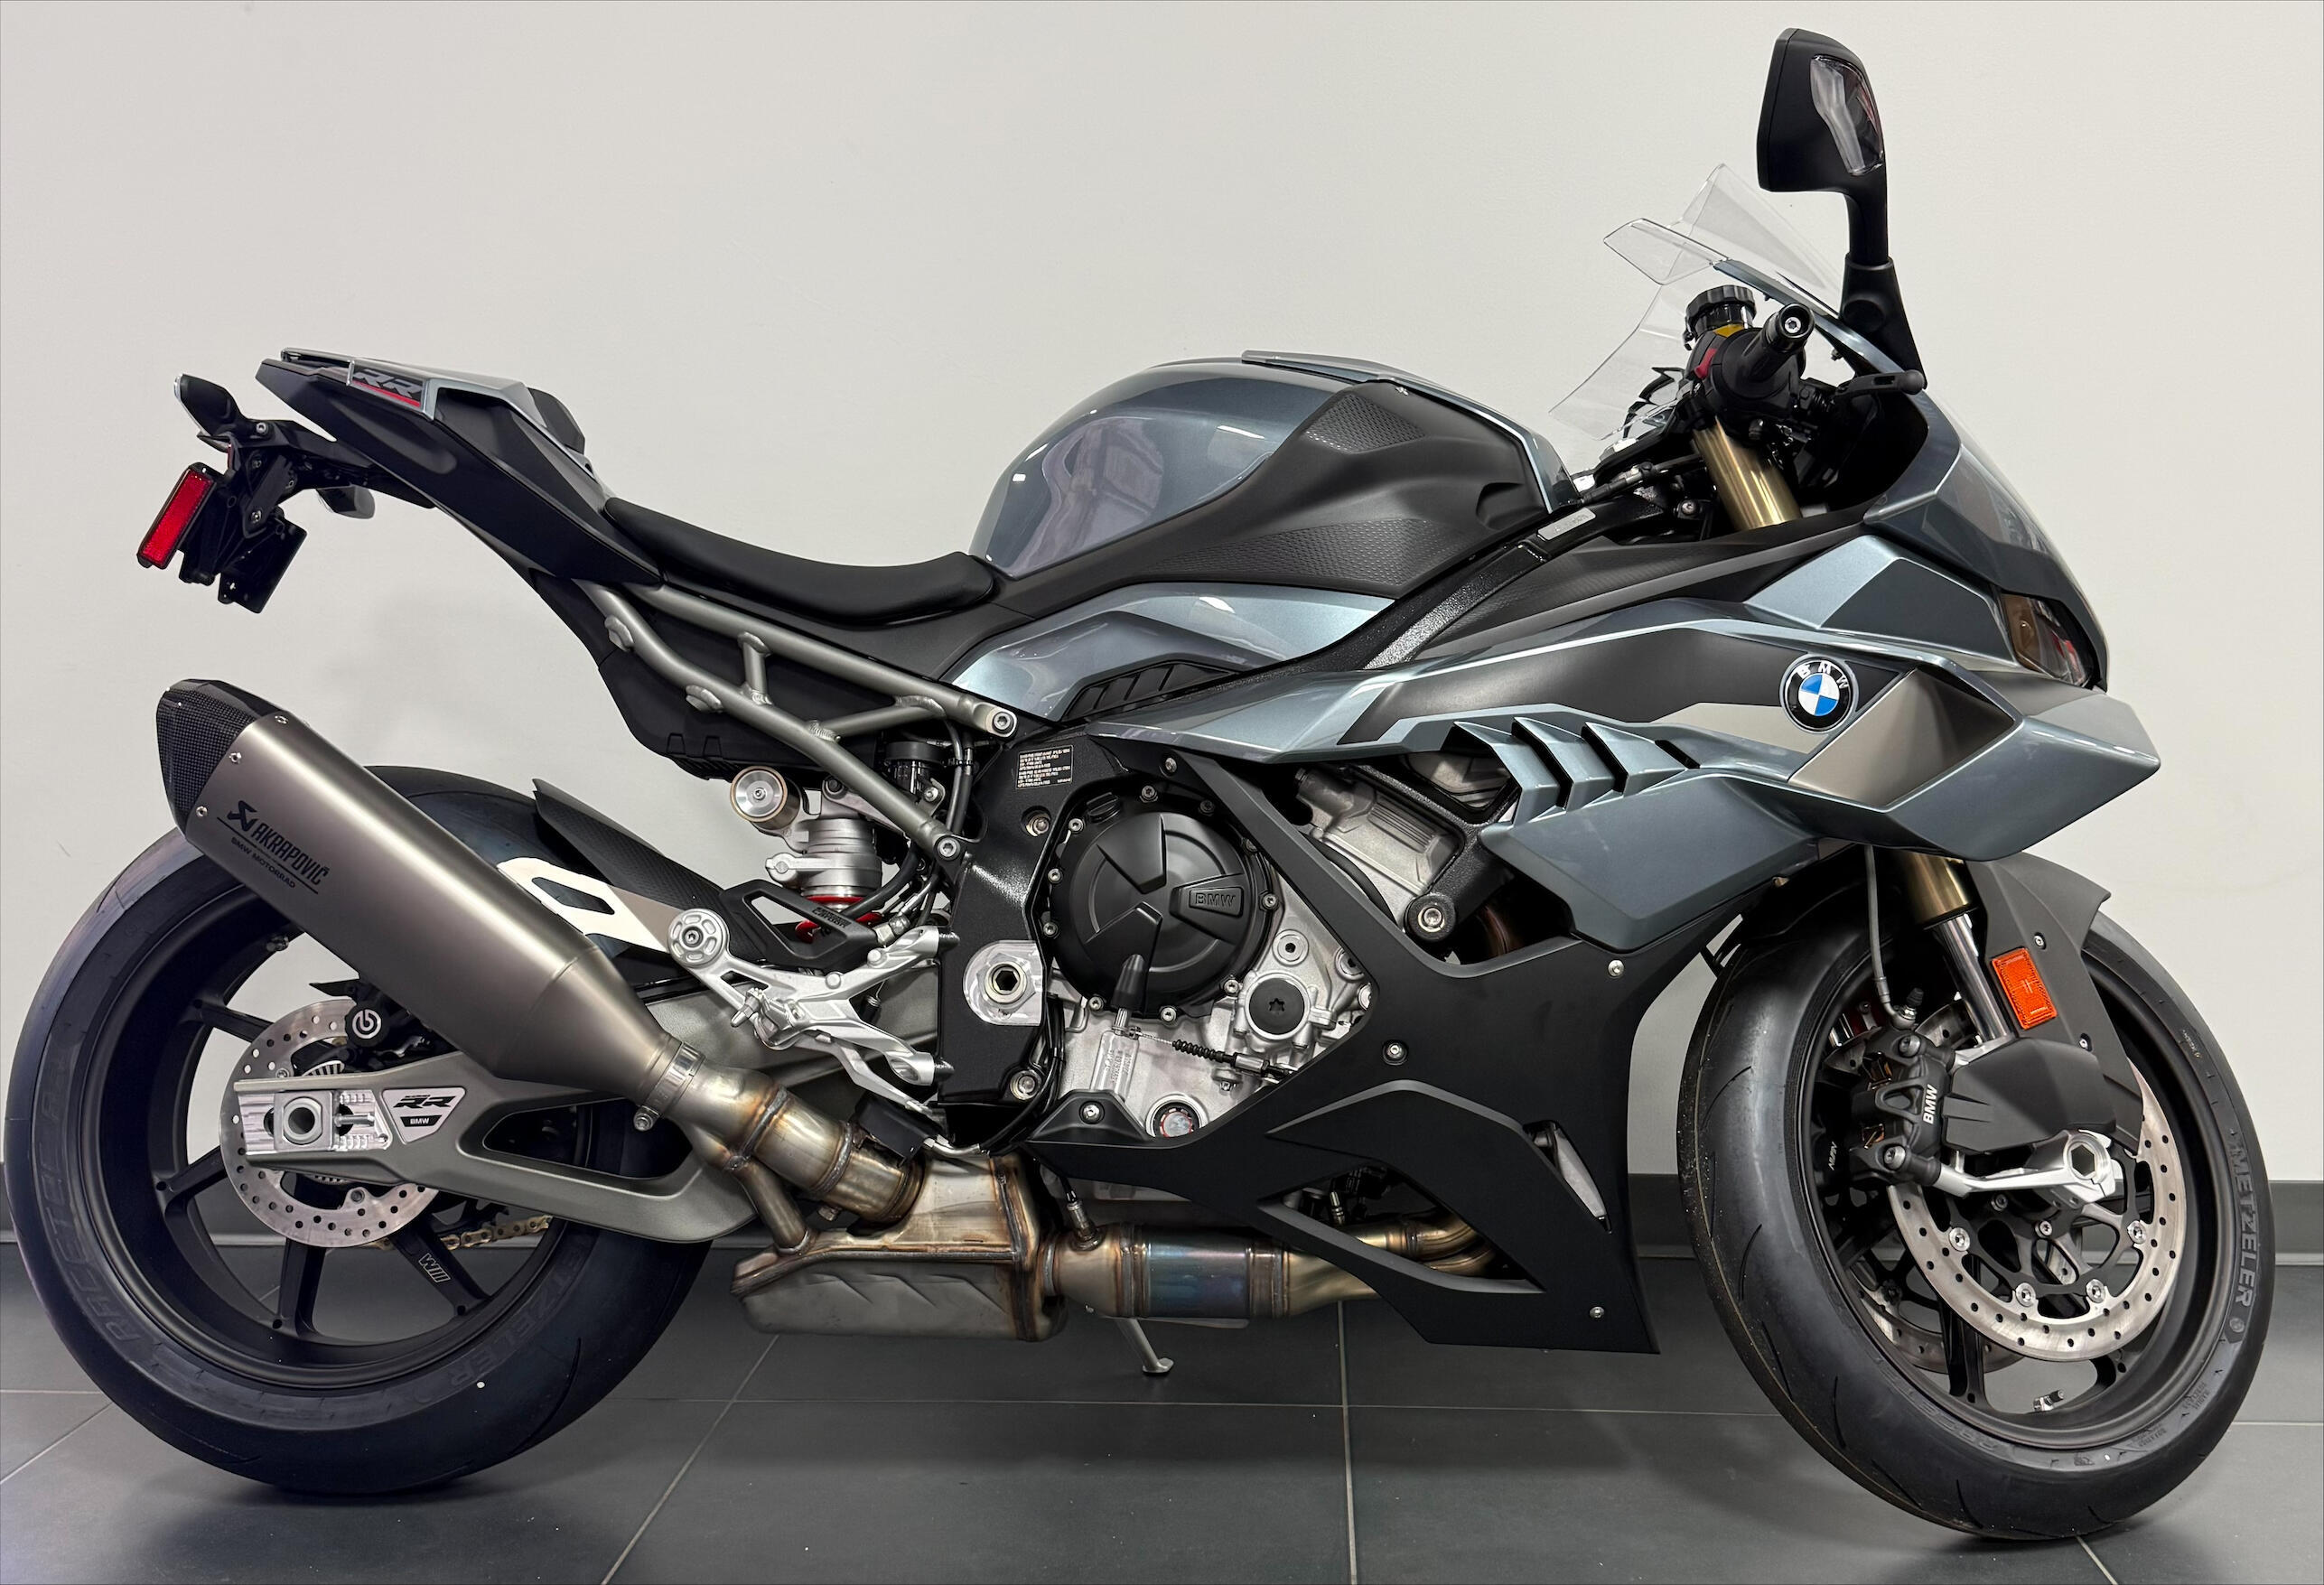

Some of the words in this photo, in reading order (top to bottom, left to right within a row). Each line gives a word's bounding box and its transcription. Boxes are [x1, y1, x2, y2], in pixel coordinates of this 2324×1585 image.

[353, 368, 424, 398] RR
[231, 836, 253, 854] BMW
[253, 852, 295, 888] MOTORRAD
[1195, 892, 1237, 908] BMW
[1923, 1084, 1937, 1124] BMW
[2233, 1151, 2258, 1308] METZELER
